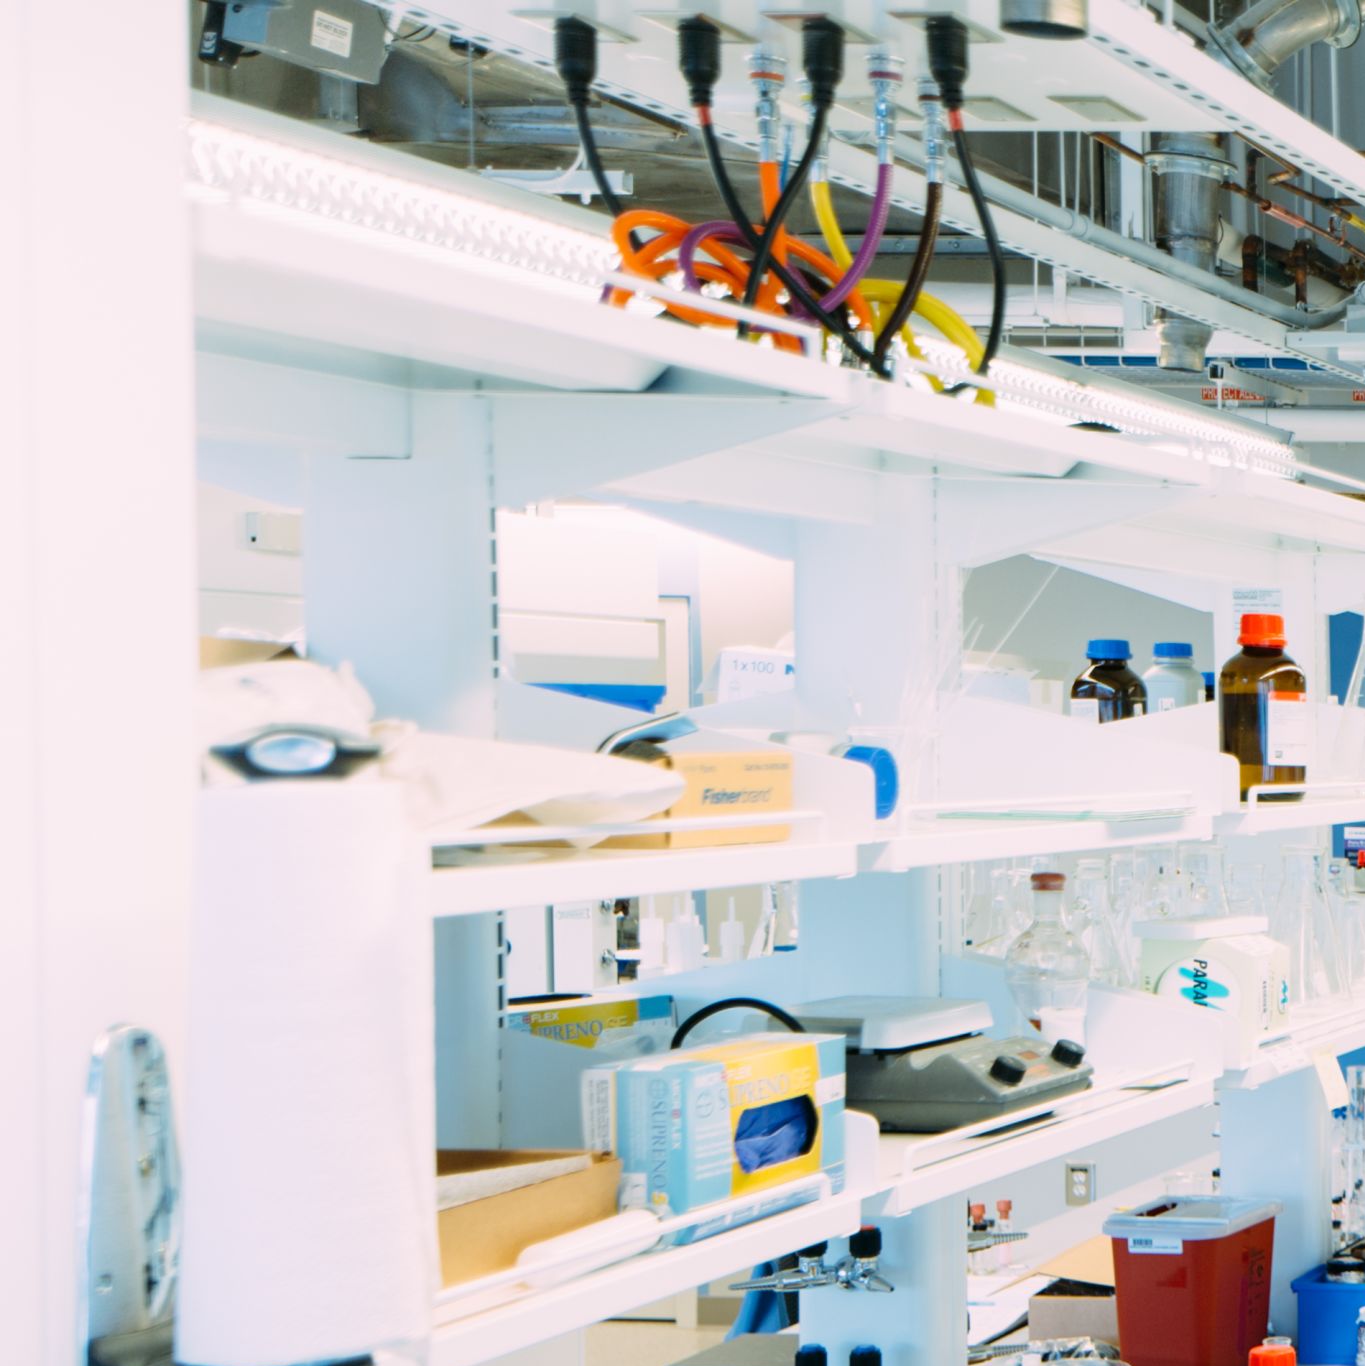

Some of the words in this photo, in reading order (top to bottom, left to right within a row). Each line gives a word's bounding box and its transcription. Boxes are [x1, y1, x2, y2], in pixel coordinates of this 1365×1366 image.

[1202, 387, 1239, 400] PROECT
[702, 787, 773, 805] Fisherbrand
[650, 1099, 668, 1190] SUPRENO
